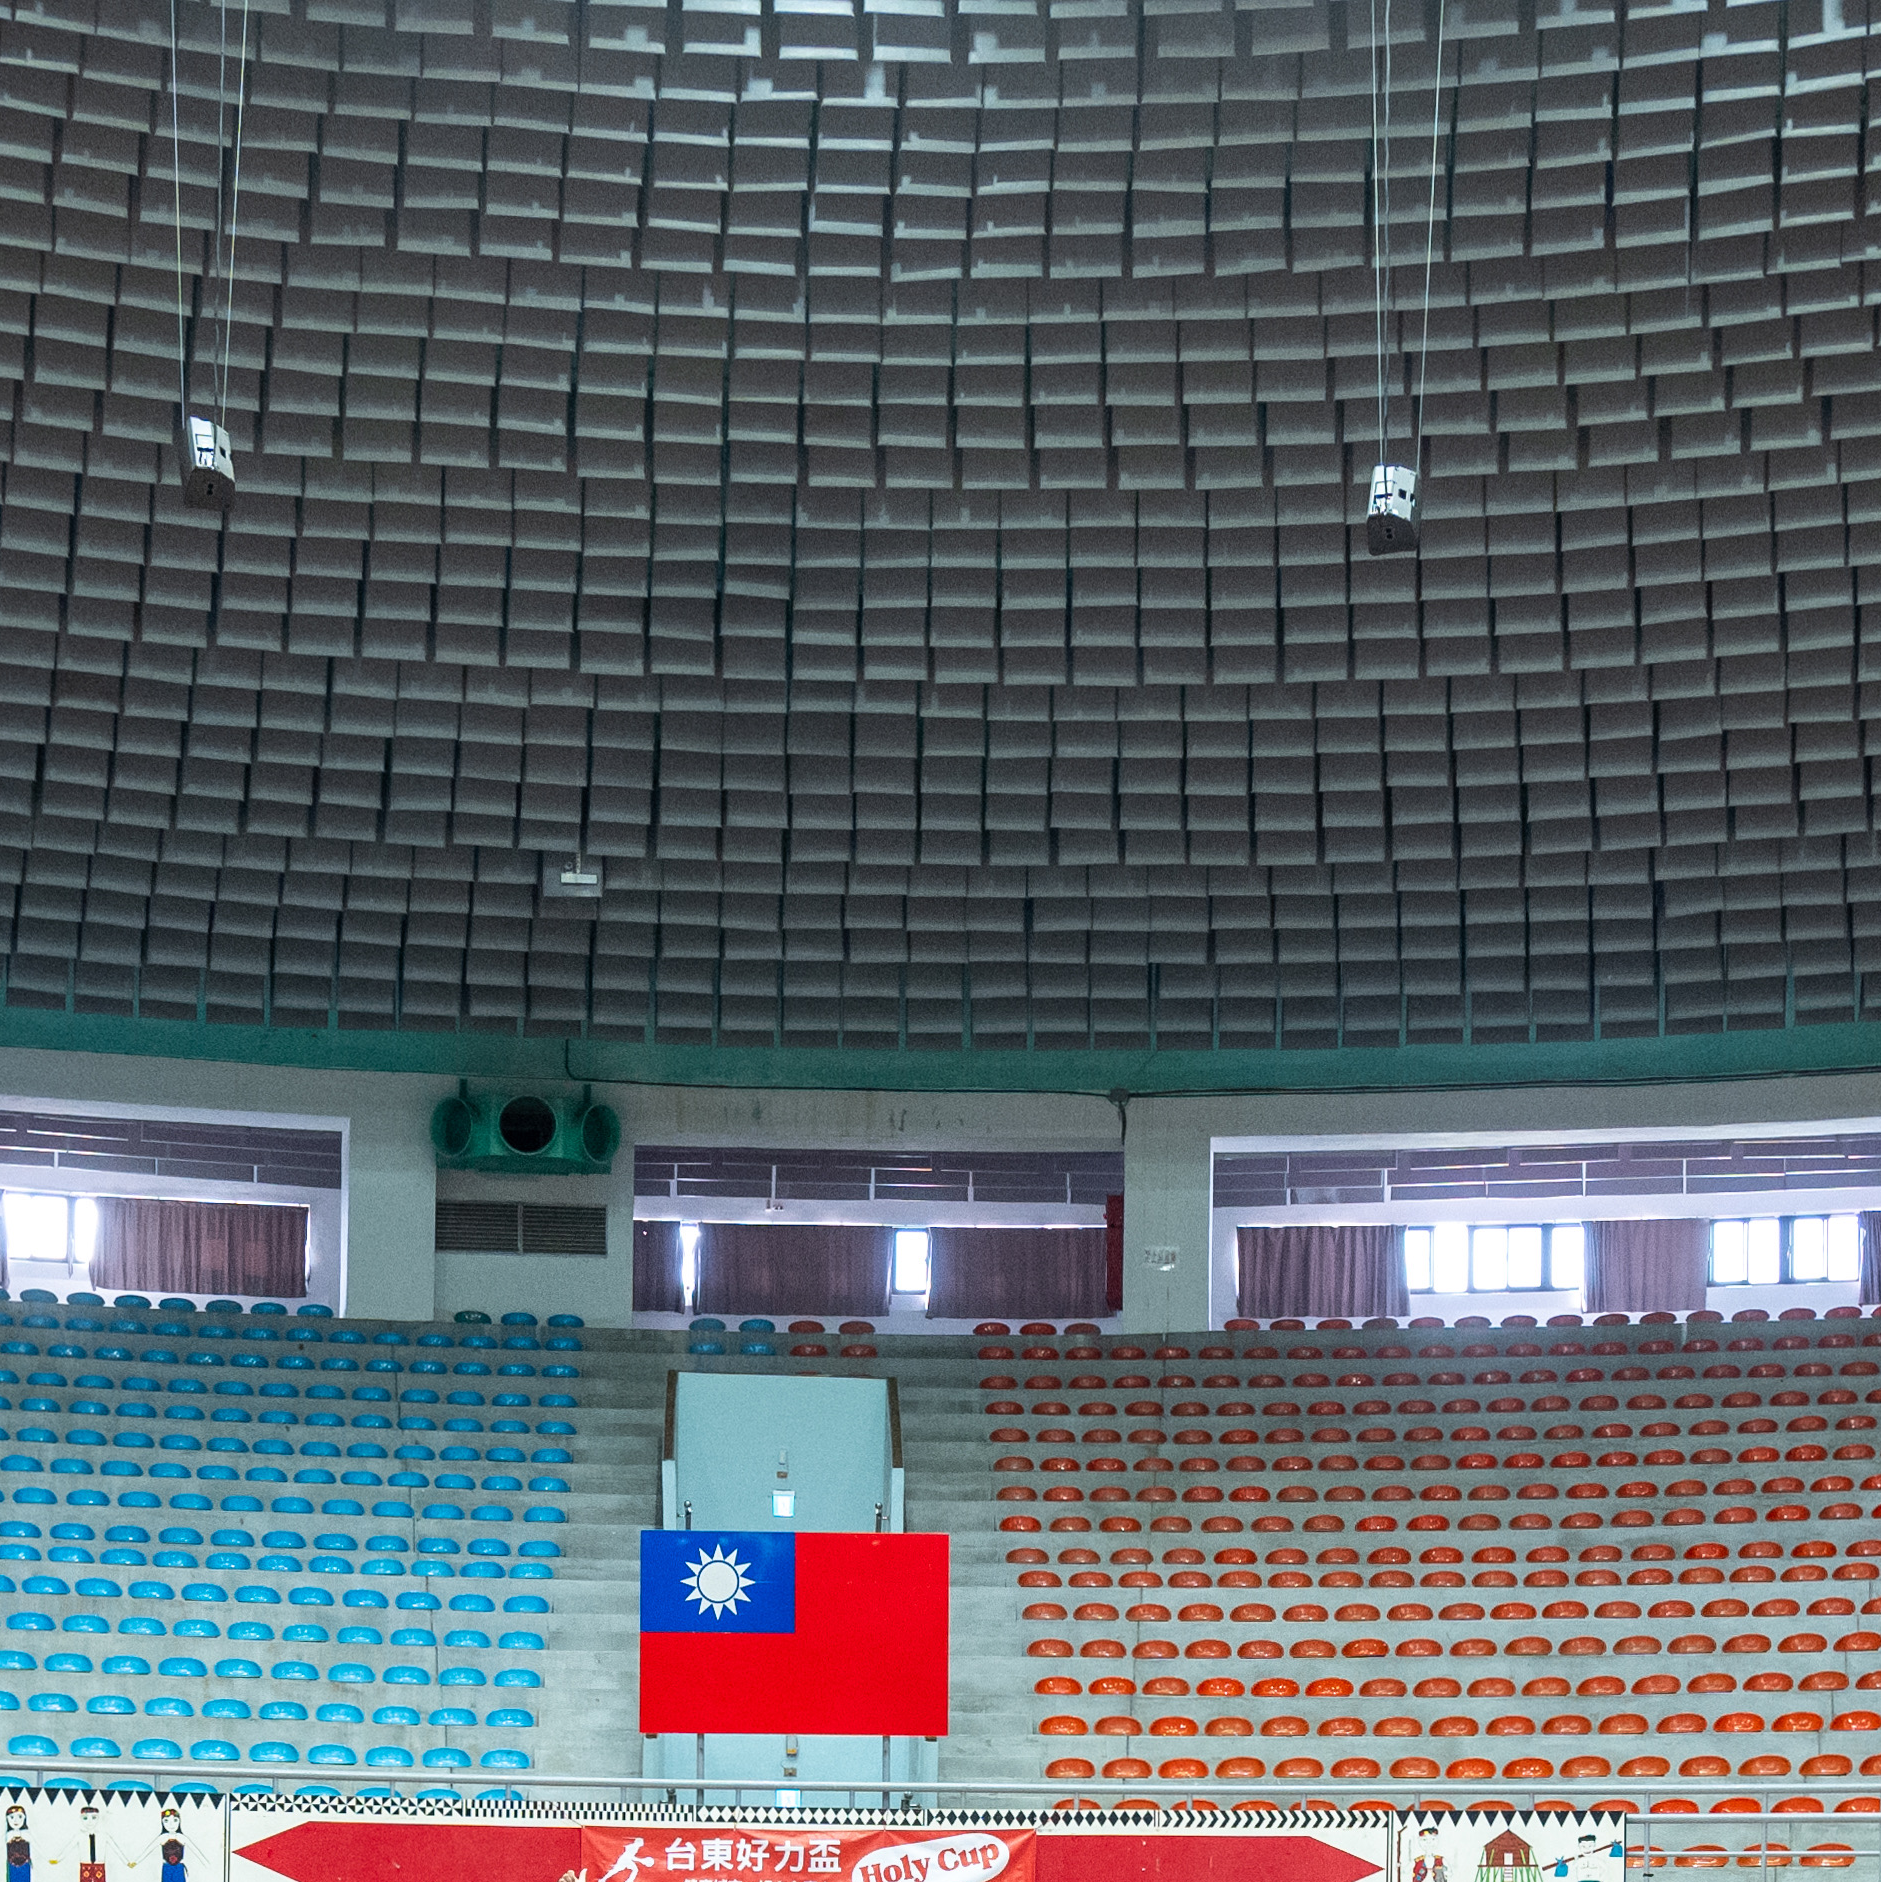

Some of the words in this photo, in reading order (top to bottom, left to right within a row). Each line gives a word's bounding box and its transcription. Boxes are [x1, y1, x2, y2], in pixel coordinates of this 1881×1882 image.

[665, 1837, 841, 1873] 台東好力盃
[938, 1843, 999, 1871] Cup
